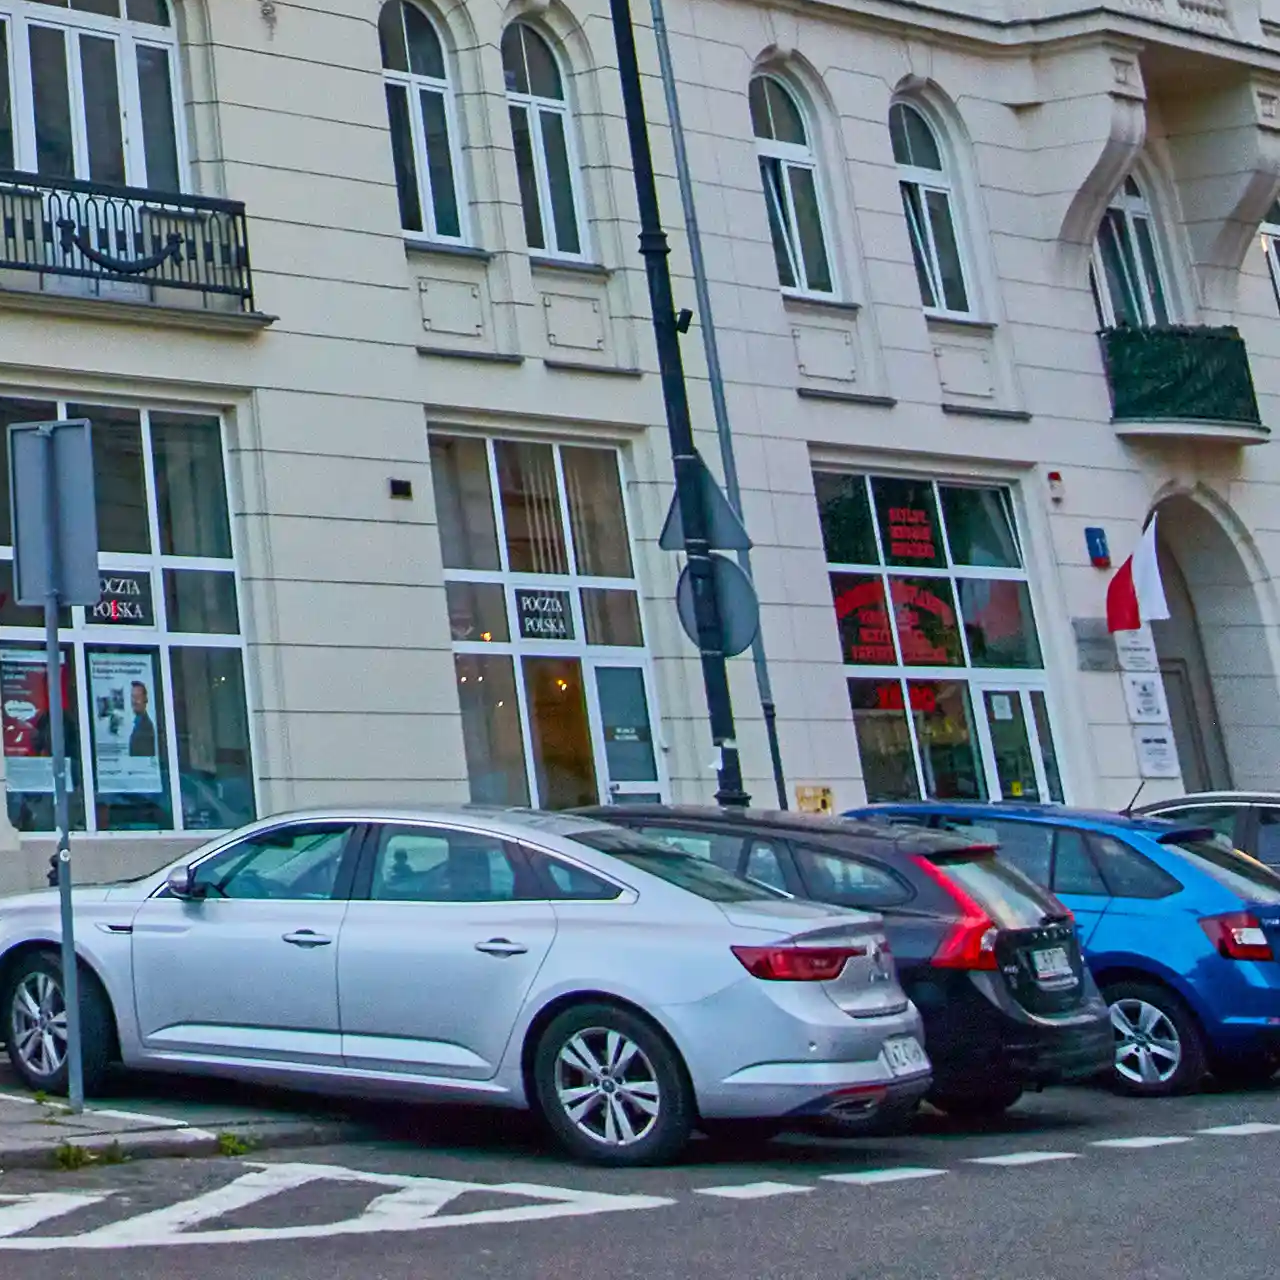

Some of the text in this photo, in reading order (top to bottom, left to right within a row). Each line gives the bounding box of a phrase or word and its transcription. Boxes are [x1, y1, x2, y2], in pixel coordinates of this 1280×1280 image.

[100, 578, 141, 595] OCZTA
[93, 601, 144, 618] POLSKA
[521, 596, 562, 612] POCZTA
[524, 617, 566, 632] POLSKA
